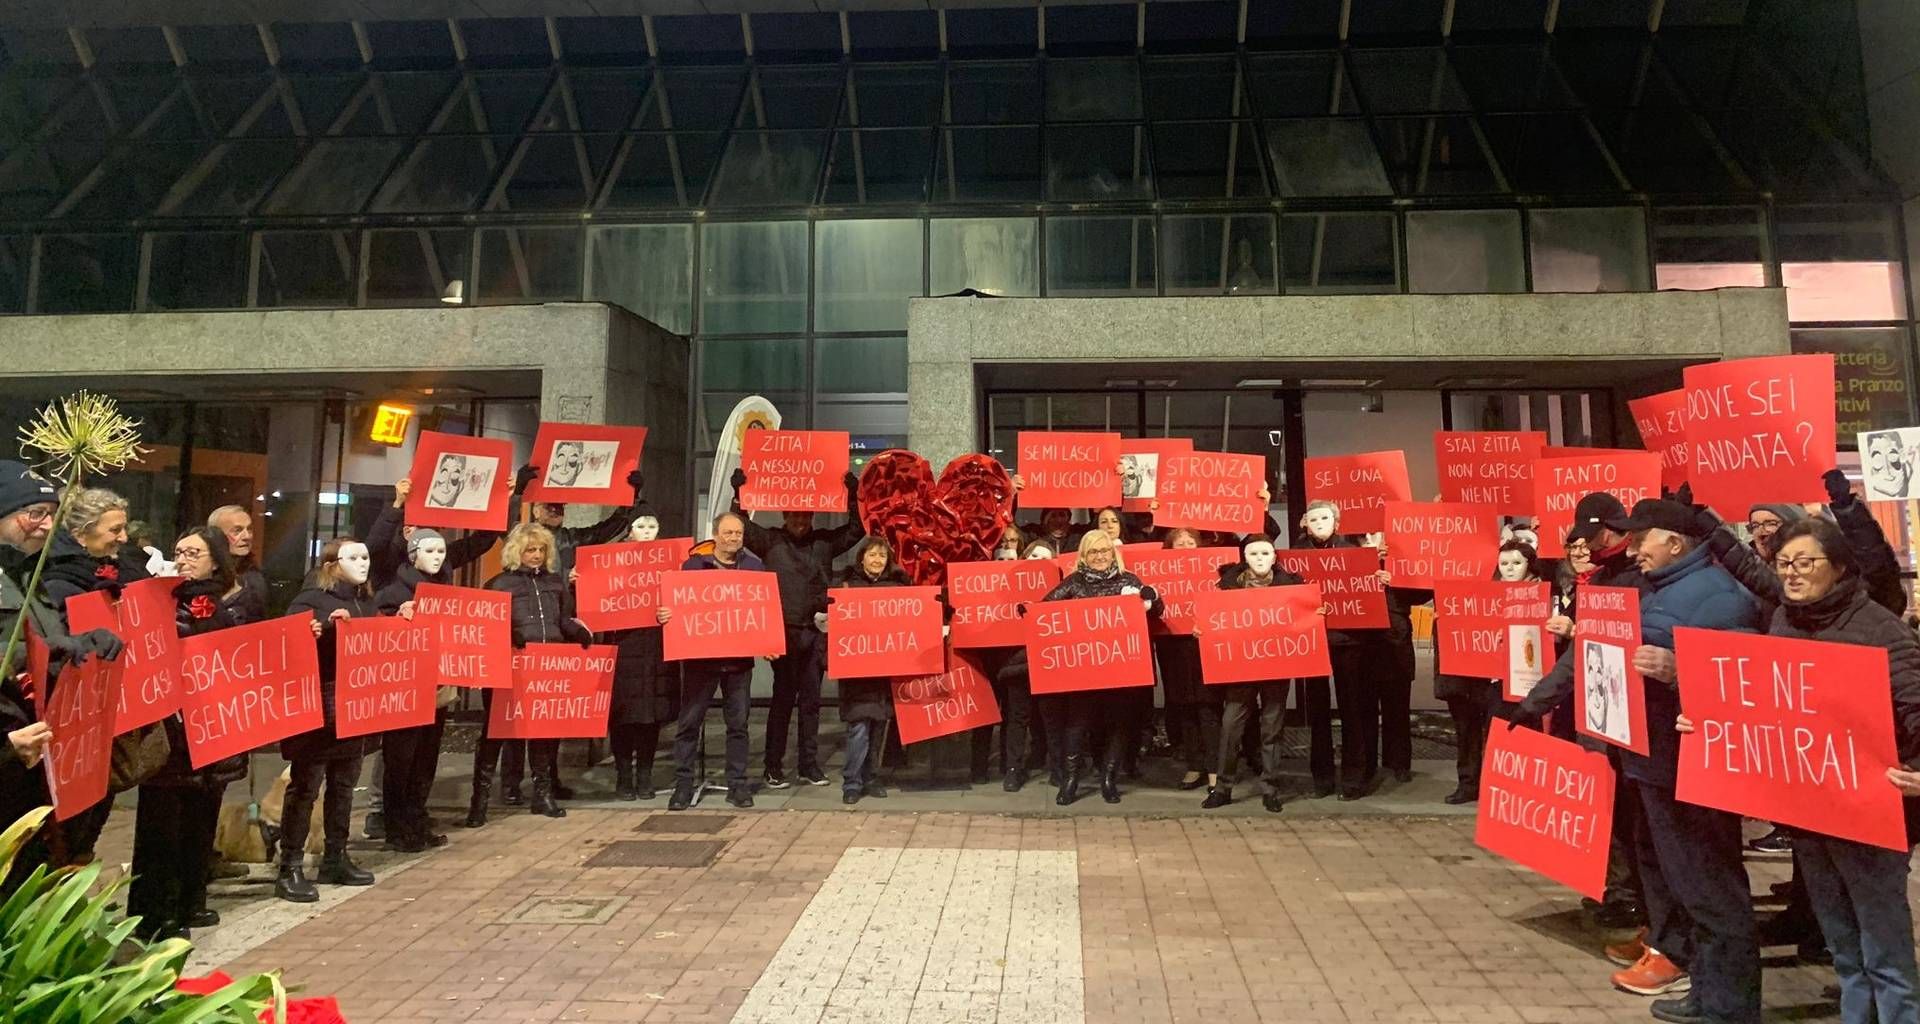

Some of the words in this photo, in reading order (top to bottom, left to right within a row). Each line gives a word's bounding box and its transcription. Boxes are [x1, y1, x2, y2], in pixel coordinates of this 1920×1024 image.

[1849, 378, 1904, 393] Pranzo
[1687, 384, 1740, 422] DOVE
[1746, 373, 1797, 416] SEI
[1444, 437, 1476, 453] STAI
[1483, 434, 1521, 453] ZITTA
[1062, 447, 1101, 462] LASCI
[750, 463, 758, 473] A
[761, 458, 825, 475] NESSUNO
[1166, 457, 1252, 480] STRONZA
[1448, 463, 1473, 478] NON
[1480, 460, 1534, 479] CAPISCI
[1554, 463, 1617, 487] TANTO
[754, 476, 817, 491] IMPORTA
[1030, 474, 1047, 487] MI
[1314, 466, 1341, 489] SEI
[1349, 468, 1384, 483] UNA
[791, 494, 814, 508] CHE
[1161, 482, 1177, 496] SE
[1184, 482, 1201, 496] MI
[1208, 482, 1249, 499] LASCI
[1461, 485, 1512, 504] NIENTE
[1546, 492, 1576, 512] NON
[1391, 516, 1424, 534] NON
[1428, 515, 1478, 535] VEDRAI
[591, 553, 612, 569] TU
[615, 549, 644, 567] NON
[648, 546, 673, 565] SEI
[1190, 557, 1201, 574] TI
[1319, 552, 1346, 572] VAI
[1398, 559, 1434, 577] TUOI
[1441, 559, 1482, 577] FIGLI
[609, 575, 624, 591] IN
[628, 570, 663, 589] GRAD
[965, 573, 1011, 593] COLPA
[1015, 570, 1047, 591] TUA
[600, 591, 651, 612] DECIDO
[673, 586, 698, 606] MA
[701, 583, 744, 602] COME
[746, 584, 770, 602] SEI
[111, 597, 140, 632] TU
[417, 597, 442, 615] NON
[445, 597, 463, 616] SEI
[466, 599, 508, 621] CAPACE
[836, 601, 862, 620] SEI
[870, 597, 923, 618] TROPPO
[955, 605, 973, 624] SE
[1342, 600, 1366, 616] ME
[1440, 597, 1459, 616] SE
[1464, 596, 1478, 616] MI
[1036, 608, 1072, 637] SEI
[1084, 605, 1128, 631] UNA
[1209, 611, 1227, 631] SE
[1233, 609, 1253, 628] LO
[344, 632, 373, 657] NON
[378, 627, 431, 653] USCIRE
[453, 625, 486, 646] FARE
[838, 631, 918, 657] SCOLLATA
[1452, 627, 1467, 652] TI
[181, 628, 287, 695] SBAGLI
[1215, 642, 1233, 662] TI
[349, 664, 377, 689] CON
[380, 656, 416, 683] QUEI
[512, 655, 520, 670] E
[521, 653, 536, 671] TI
[540, 656, 581, 672] HANNO
[585, 657, 615, 673] DATO
[526, 680, 571, 694] ANCHE
[898, 665, 976, 703] COPRITI
[1711, 656, 1755, 707] TE
[1772, 660, 1817, 714] NE
[345, 698, 374, 723] TUOI
[378, 688, 417, 716] AMICI
[505, 701, 524, 721] LA
[922, 692, 979, 727] TROIA
[1703, 719, 1858, 791] PENTIRAI
[1492, 748, 1528, 782] NON
[1534, 757, 1548, 788] TI
[1555, 765, 1595, 806] DEVI
[1489, 785, 1597, 853] TRUCCARE!
